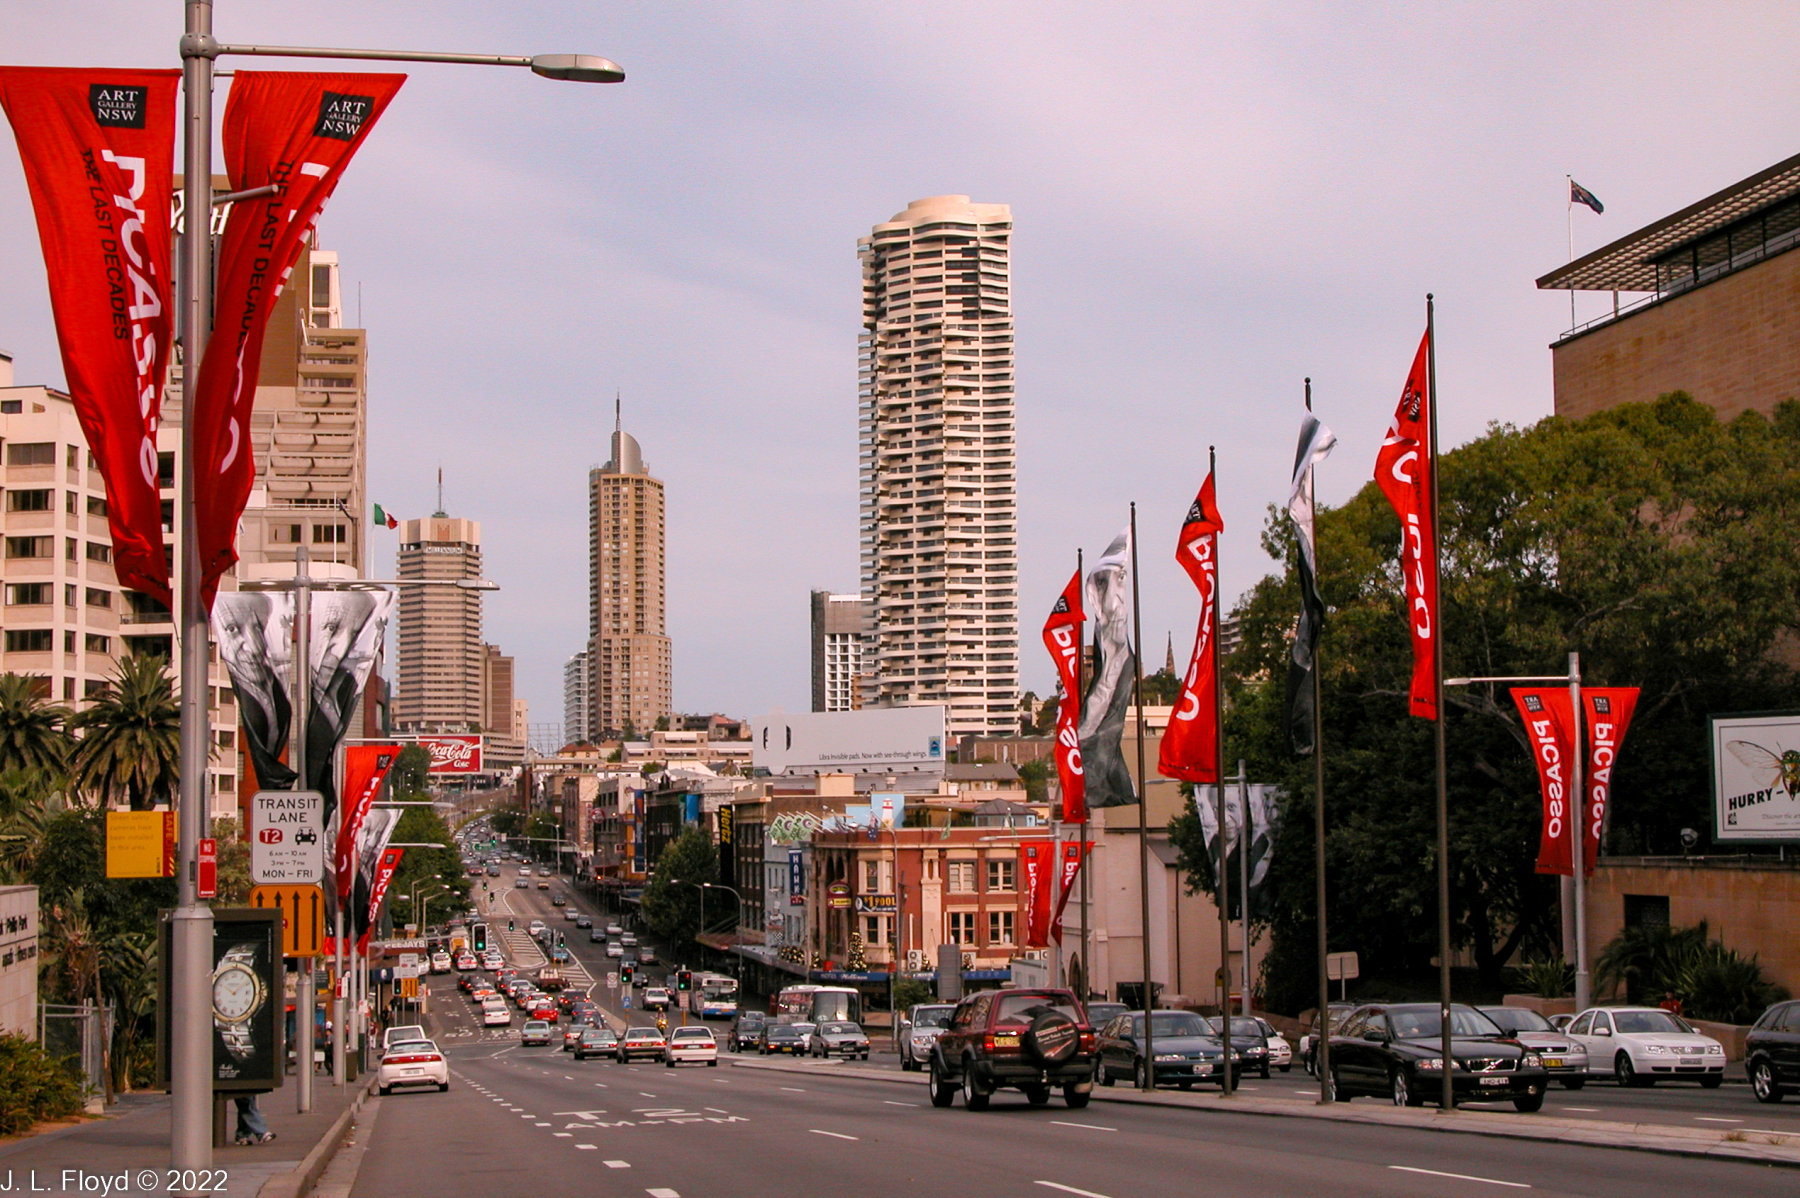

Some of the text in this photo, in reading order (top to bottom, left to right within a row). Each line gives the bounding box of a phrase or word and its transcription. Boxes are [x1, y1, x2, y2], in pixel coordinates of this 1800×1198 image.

[98, 89, 139, 102] ART
[97, 100, 137, 110] GALLERY
[327, 100, 366, 115] ART
[98, 107, 137, 121] NSW
[322, 119, 360, 135] NSW
[272, 159, 295, 199] THE
[89, 186, 115, 236] LAST
[258, 202, 284, 253] LAST
[101, 238, 130, 341] DECADES
[884, 750, 912, 759] see-through
[258, 798, 319, 809] TRANSIT
[1729, 788, 1773, 811] HURRY
[268, 812, 307, 823] LANE
[721, 807, 732, 844] Hertz
[262, 830, 281, 843] T2
[262, 869, 285, 878] MON
[297, 869, 313, 878] FRI
[792, 855, 801, 894] HAWK
